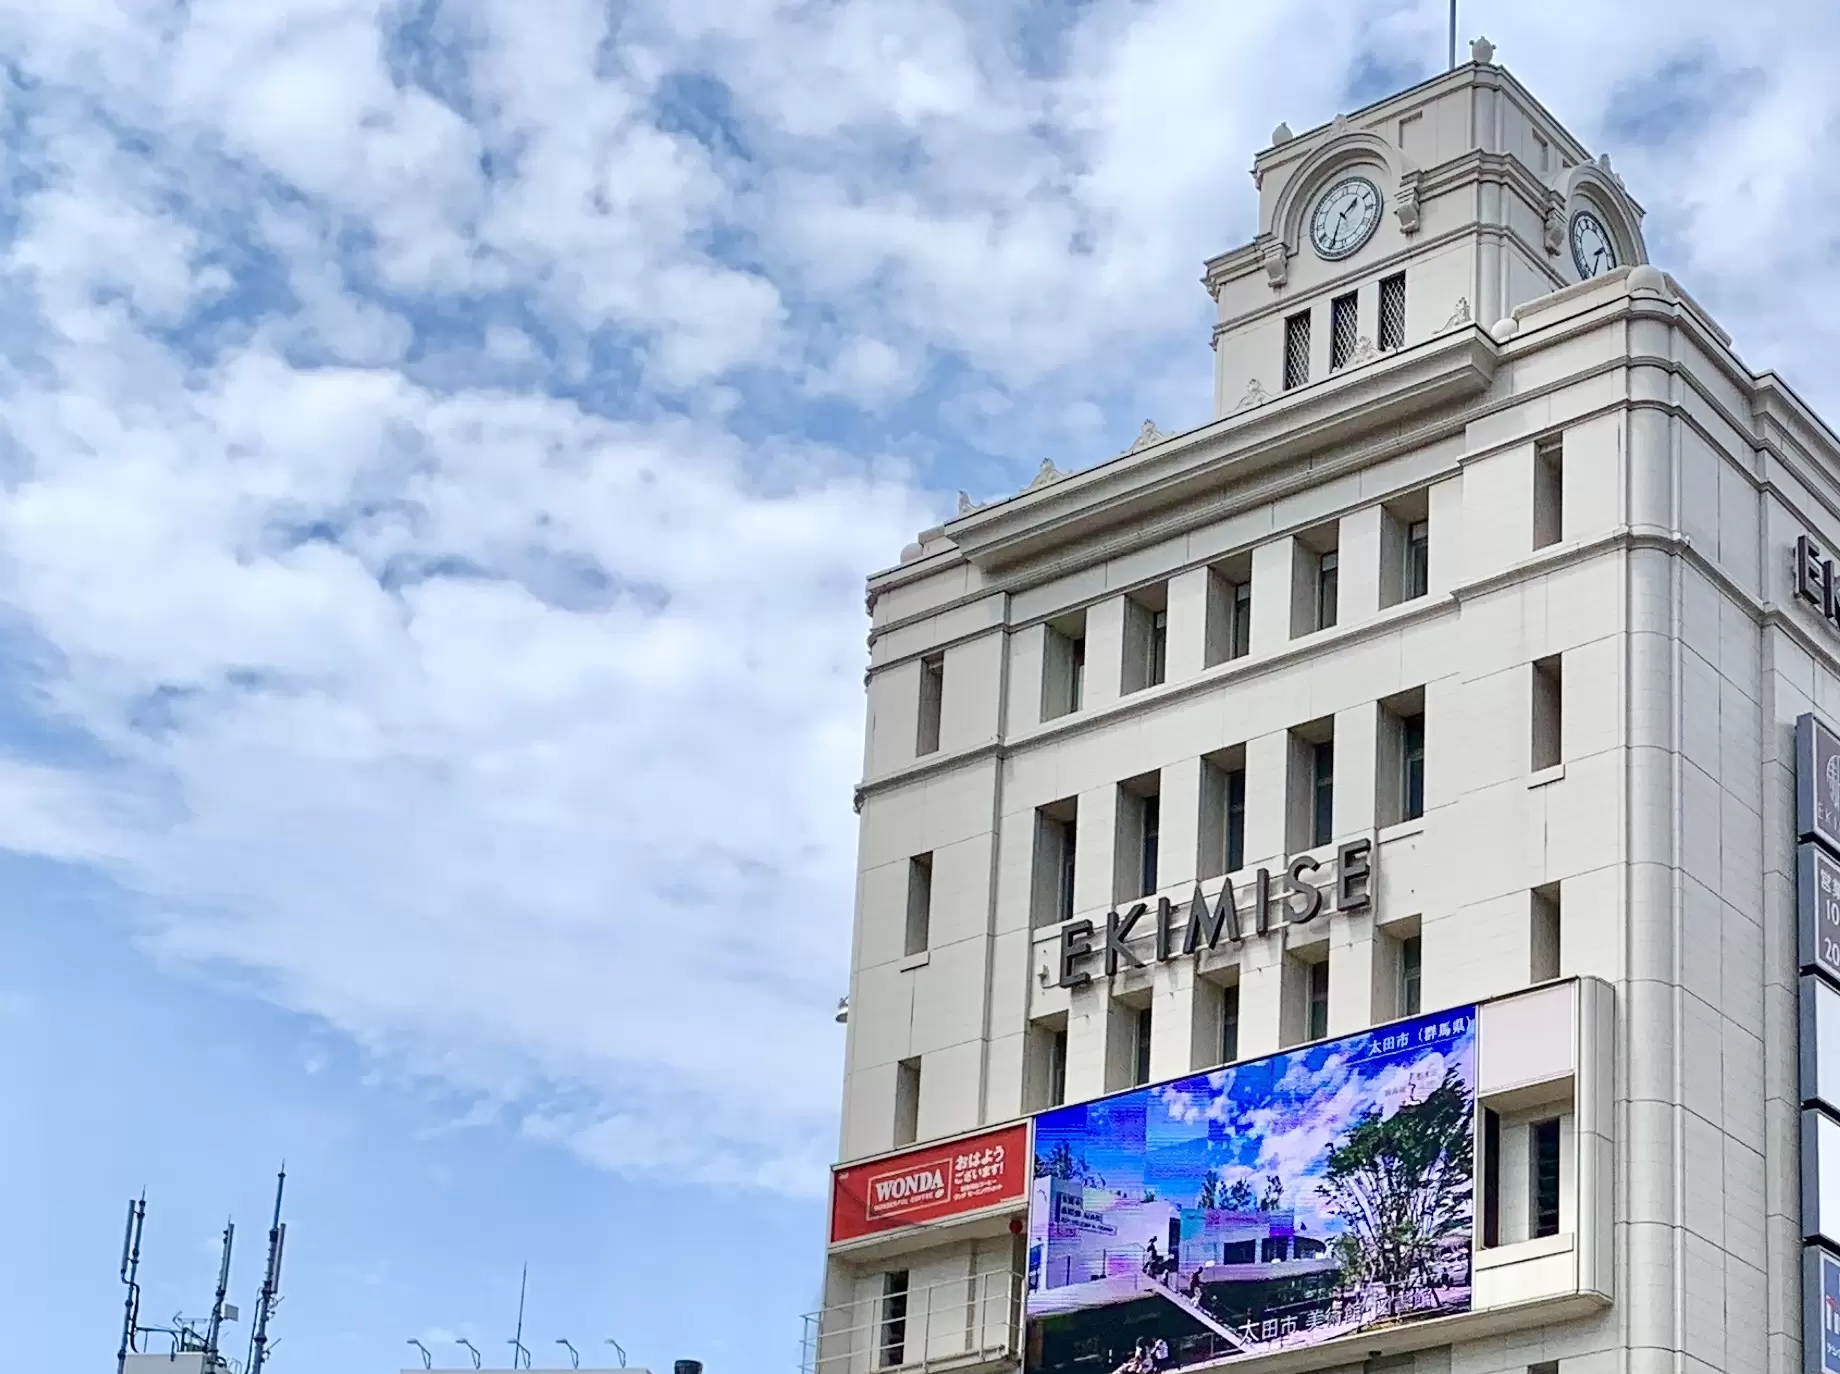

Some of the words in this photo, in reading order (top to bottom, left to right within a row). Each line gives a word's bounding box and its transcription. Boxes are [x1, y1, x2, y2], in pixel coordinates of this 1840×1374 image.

[1059, 838, 1371, 988] EKIMISE
[954, 1145, 1005, 1171] おはよう
[875, 1168, 945, 1202] WONDA
[1239, 1315, 1299, 1347] 太田市
